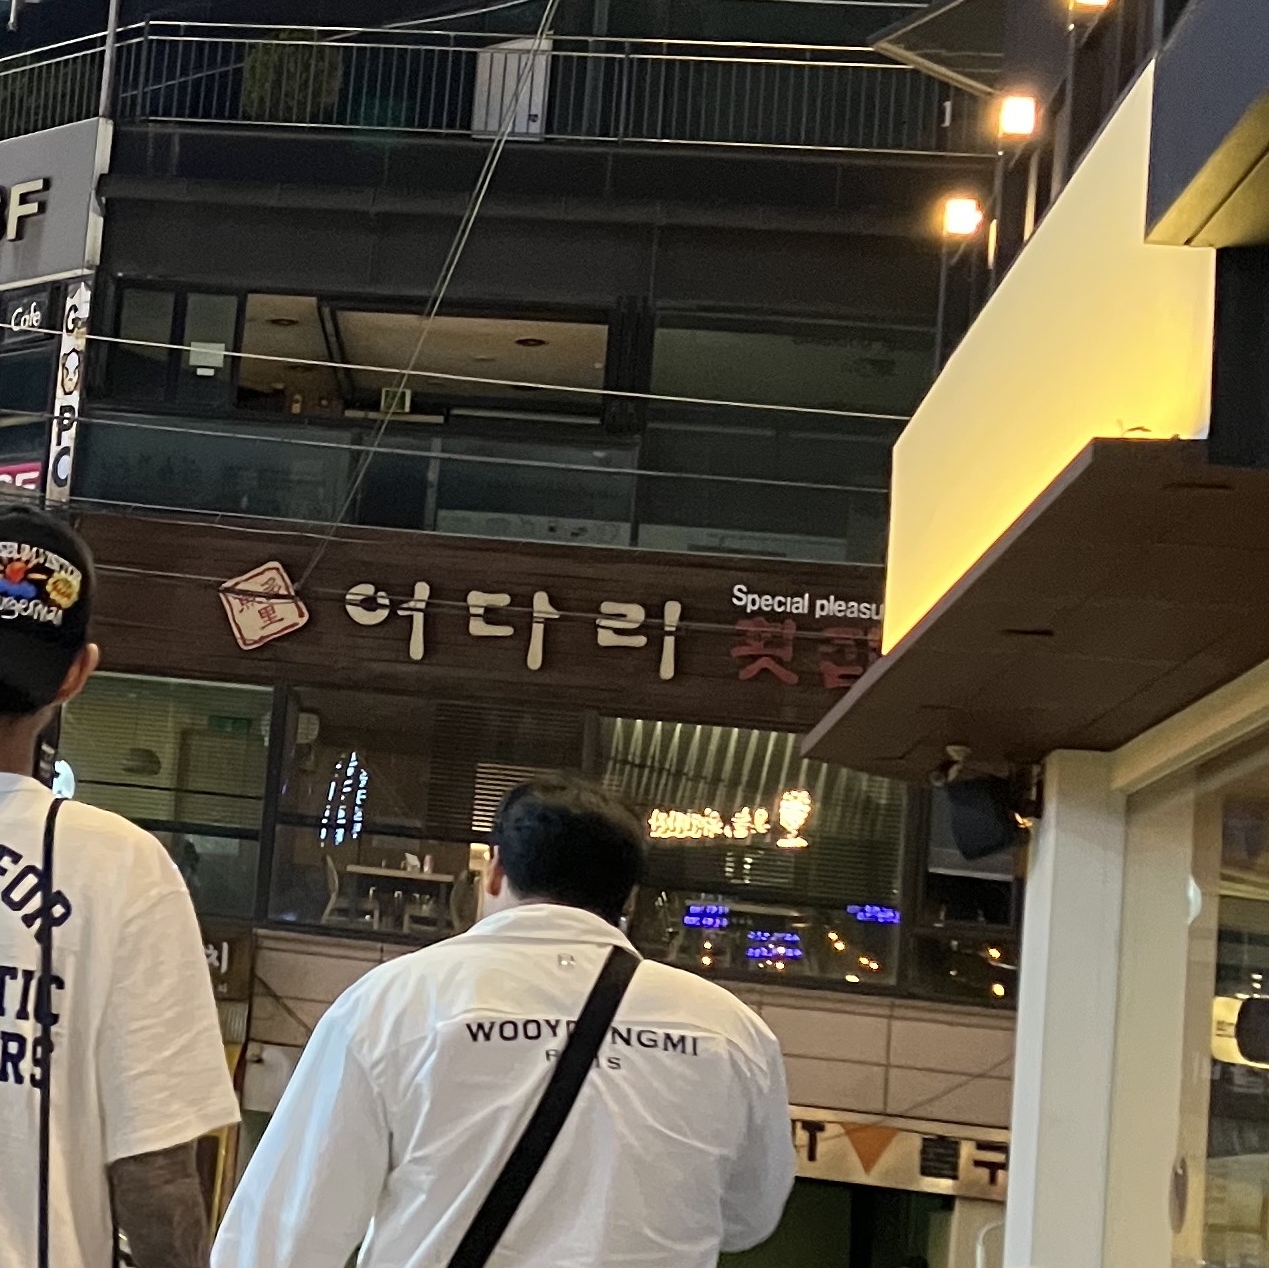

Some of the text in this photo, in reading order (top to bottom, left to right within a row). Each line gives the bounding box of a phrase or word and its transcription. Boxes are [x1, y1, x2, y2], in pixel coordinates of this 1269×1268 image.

[732, 584, 884, 620] Special pleasu
[344, 581, 682, 680] 어다리
[466, 1018, 698, 1056] WOOYNGMI
